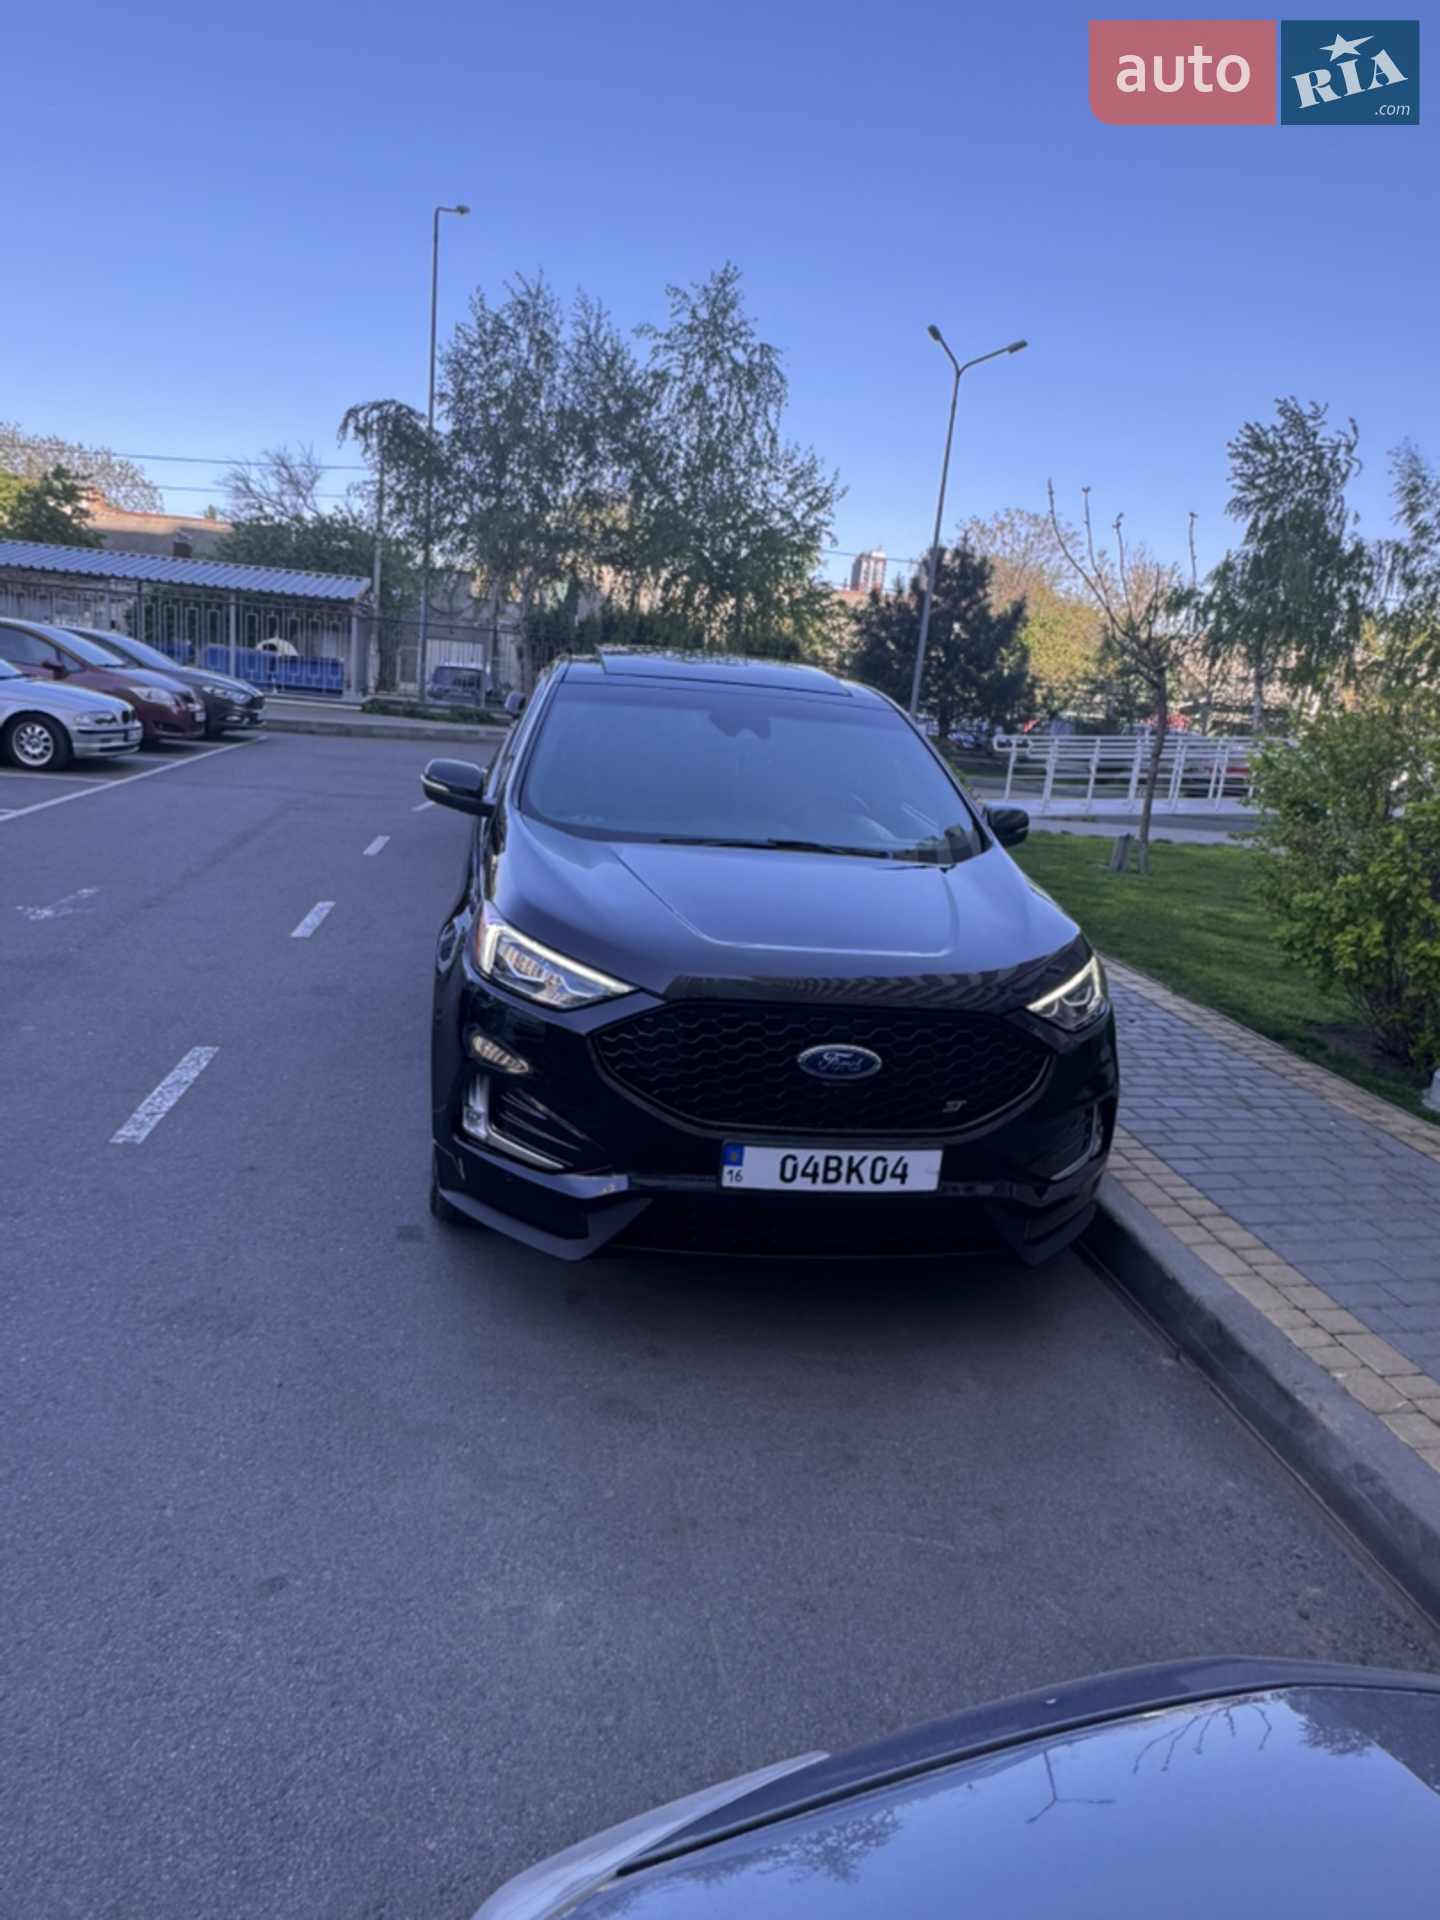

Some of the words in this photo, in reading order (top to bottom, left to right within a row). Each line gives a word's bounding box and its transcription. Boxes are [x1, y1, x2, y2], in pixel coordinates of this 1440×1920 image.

[818, 1052, 863, 1072] Ford
[727, 1169, 743, 1183] 16
[779, 1154, 908, 1185] 04BK04
